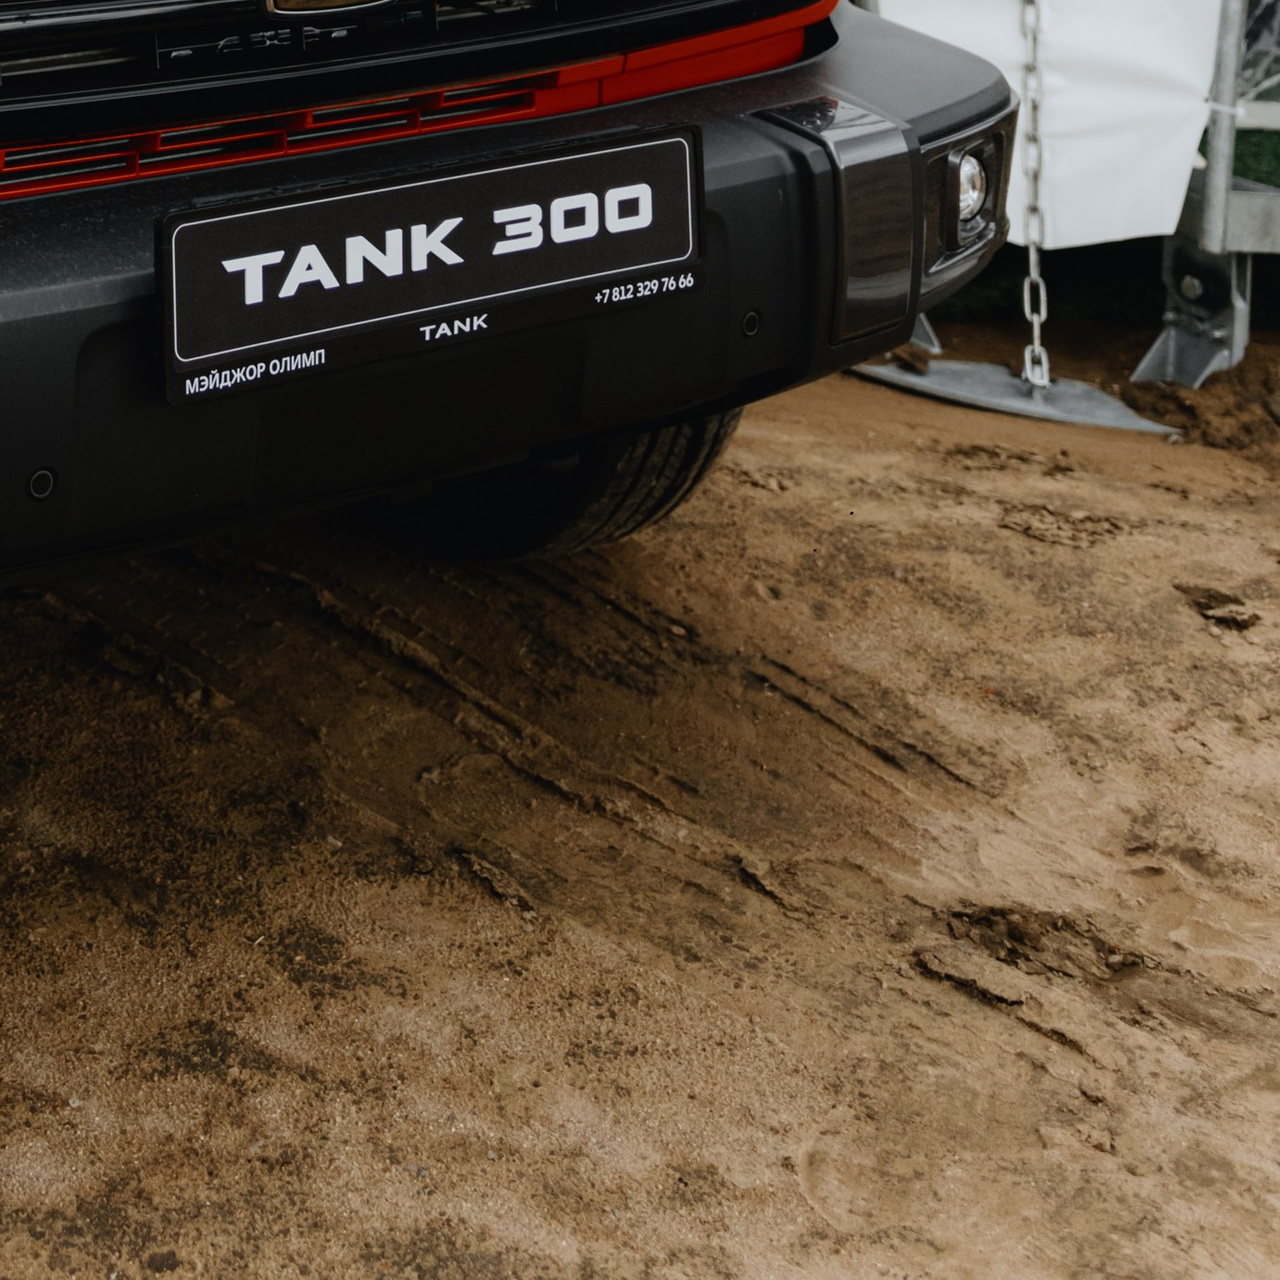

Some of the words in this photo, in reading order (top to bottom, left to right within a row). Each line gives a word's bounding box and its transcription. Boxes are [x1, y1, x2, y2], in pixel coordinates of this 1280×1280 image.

[222, 217, 465, 305] TANK
[492, 183, 653, 256] 300
[595, 289, 610, 303] +7
[612, 284, 634, 301] 812
[637, 280, 659, 297] 329
[661, 276, 676, 292] 76
[678, 273, 694, 288] 66
[420, 313, 488, 340] TANK
[185, 362, 266, 395] МЭЙДЖОР
[269, 348, 325, 376] ОЛИМП
